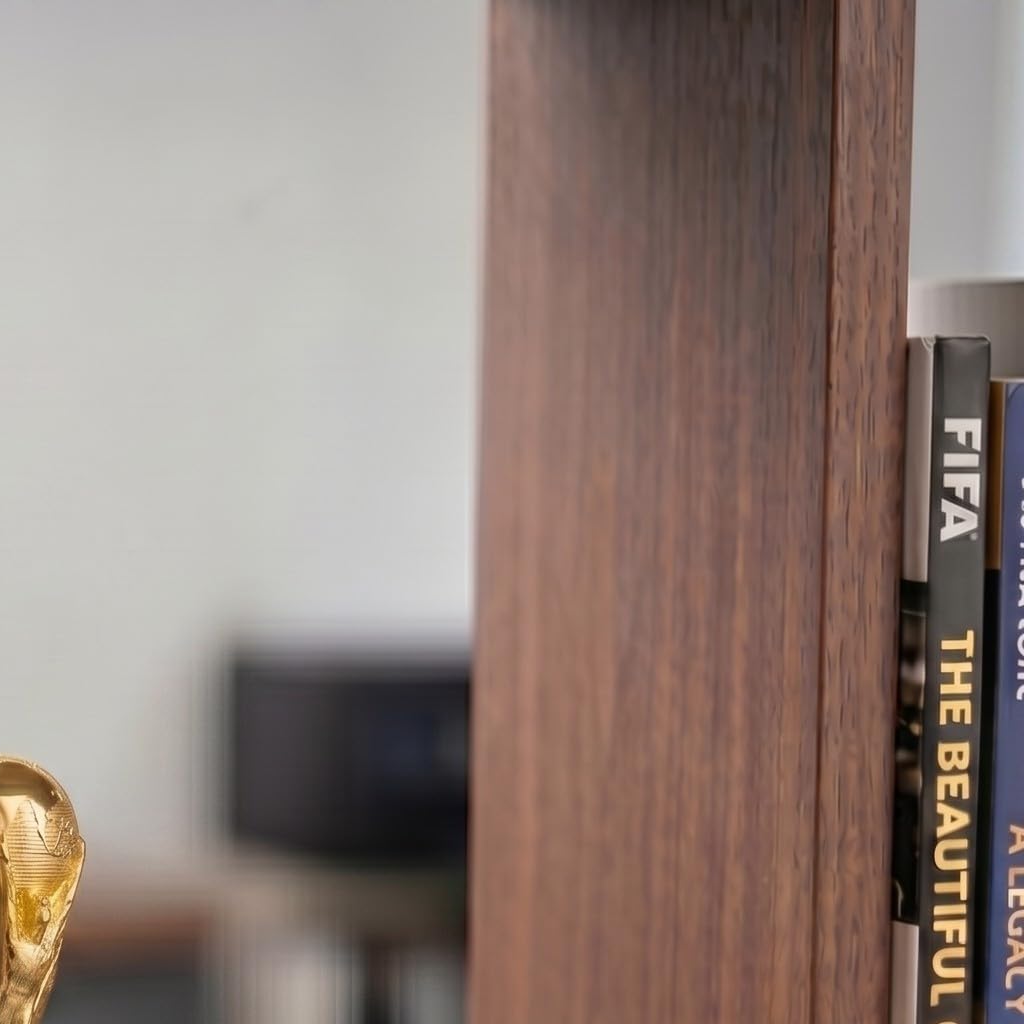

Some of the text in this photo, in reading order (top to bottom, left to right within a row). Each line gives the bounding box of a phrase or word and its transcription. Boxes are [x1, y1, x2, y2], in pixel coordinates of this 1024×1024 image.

[940, 417, 982, 542] FIFA
[939, 629, 975, 726] THE
[929, 741, 972, 1007] BEAUTIFUL
